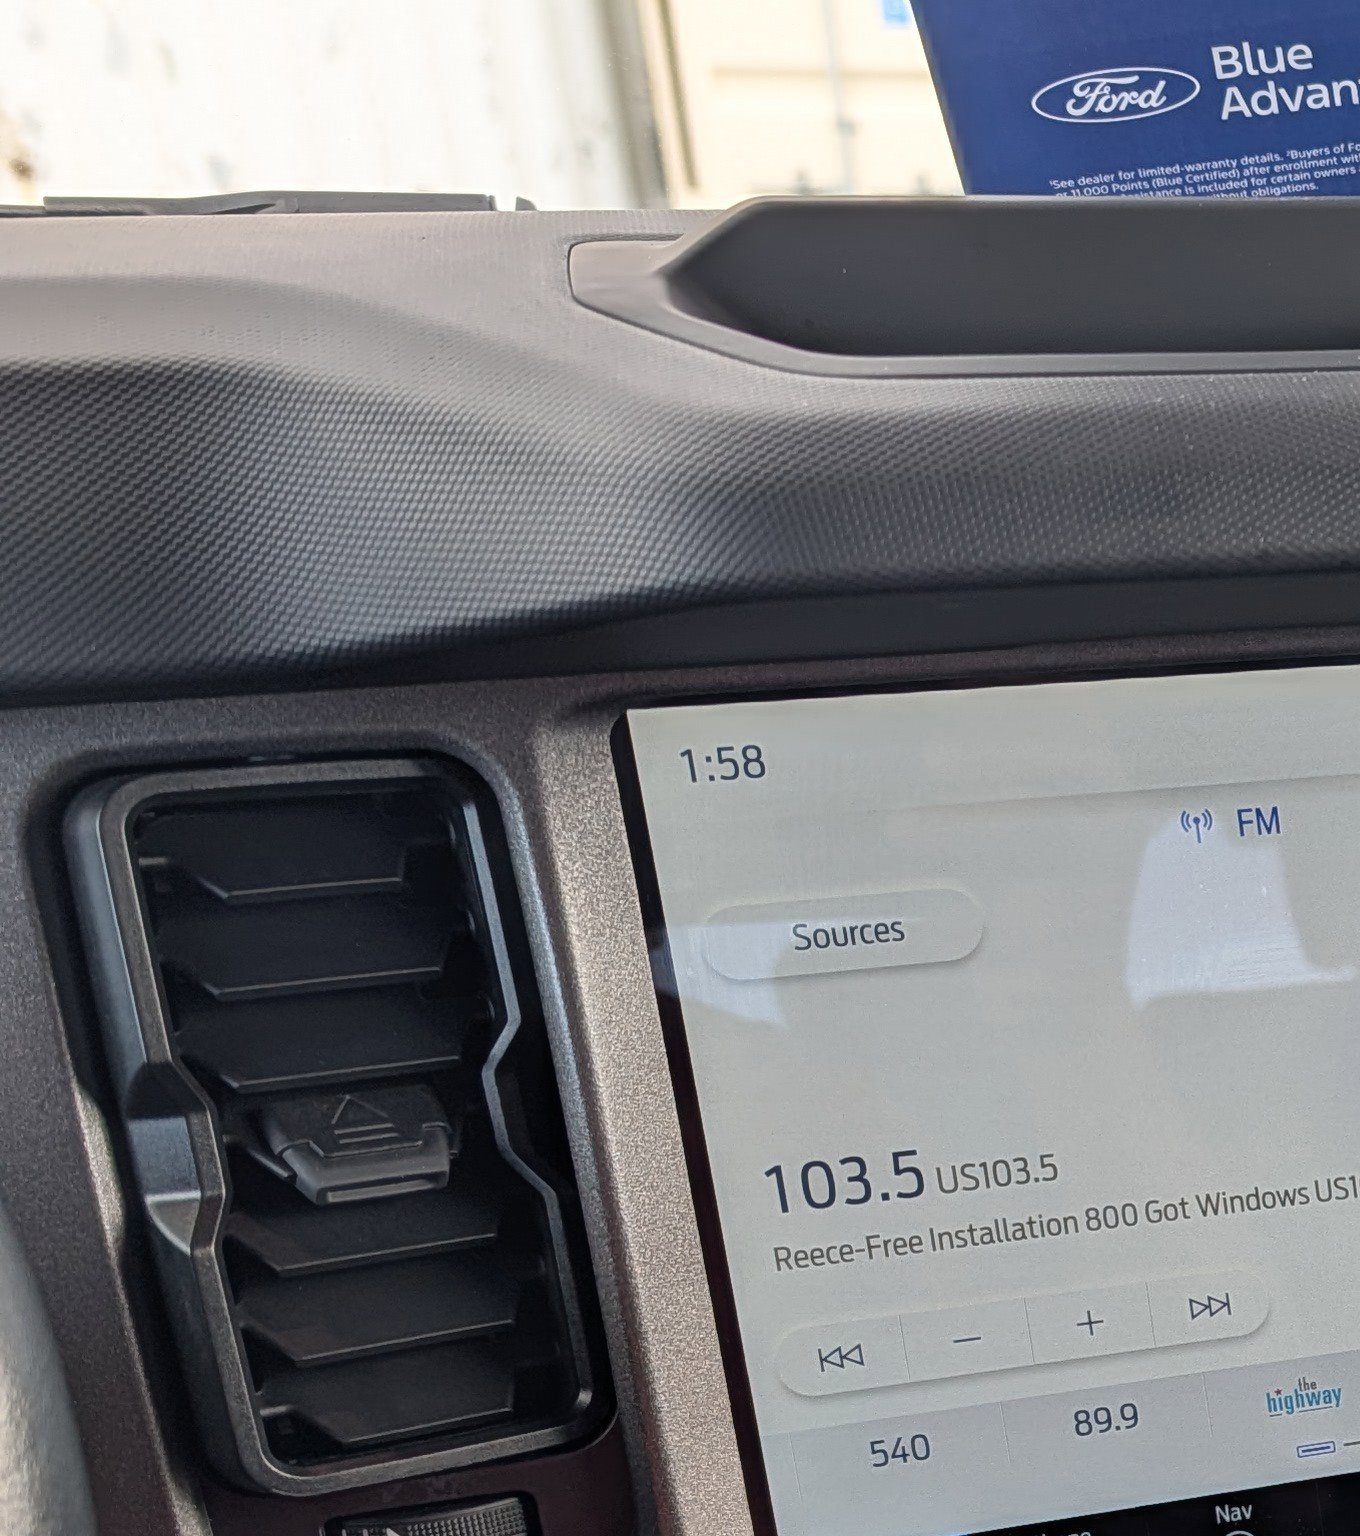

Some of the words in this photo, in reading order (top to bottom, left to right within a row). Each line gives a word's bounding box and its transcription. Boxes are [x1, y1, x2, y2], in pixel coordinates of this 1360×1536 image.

[1211, 41, 1314, 80] Blue
[1065, 74, 1168, 117] Ford
[1077, 171, 1115, 187] dealer
[1117, 169, 1136, 182] for
[1139, 156, 1238, 181] limited-warranty
[1240, 150, 1284, 166] details.
[1332, 142, 1345, 155] of
[1112, 178, 1151, 194] Points
[1151, 174, 1183, 191] (Blue
[1185, 166, 1241, 187] Certified)
[1243, 163, 1272, 177] after
[1273, 154, 1340, 173] enrollment
[1184, 183, 1195, 195] is
[1197, 176, 1249, 194] included
[1250, 174, 1268, 187] for
[1270, 168, 1311, 184] certain
[1313, 165, 1357, 179] owners
[1251, 178, 1319, 197] obligations.
[679, 743, 768, 783] 1:58
[1237, 806, 1282, 838] FM
[792, 917, 906, 952] Sources
[764, 1147, 927, 1216] 103.5
[935, 1152, 1060, 1196] US103.5
[772, 1228, 924, 1273] Reece-Free
[929, 1209, 1081, 1254] Installation
[1084, 1199, 1140, 1234] 800
[1144, 1193, 1191, 1226] Got
[1195, 1181, 1310, 1219] Windows
[1265, 1387, 1342, 1415] highway
[1298, 1376, 1318, 1392] the
[1072, 1401, 1141, 1438] 89.9
[869, 1432, 932, 1469] 540
[1214, 1502, 1254, 1526] Nav
